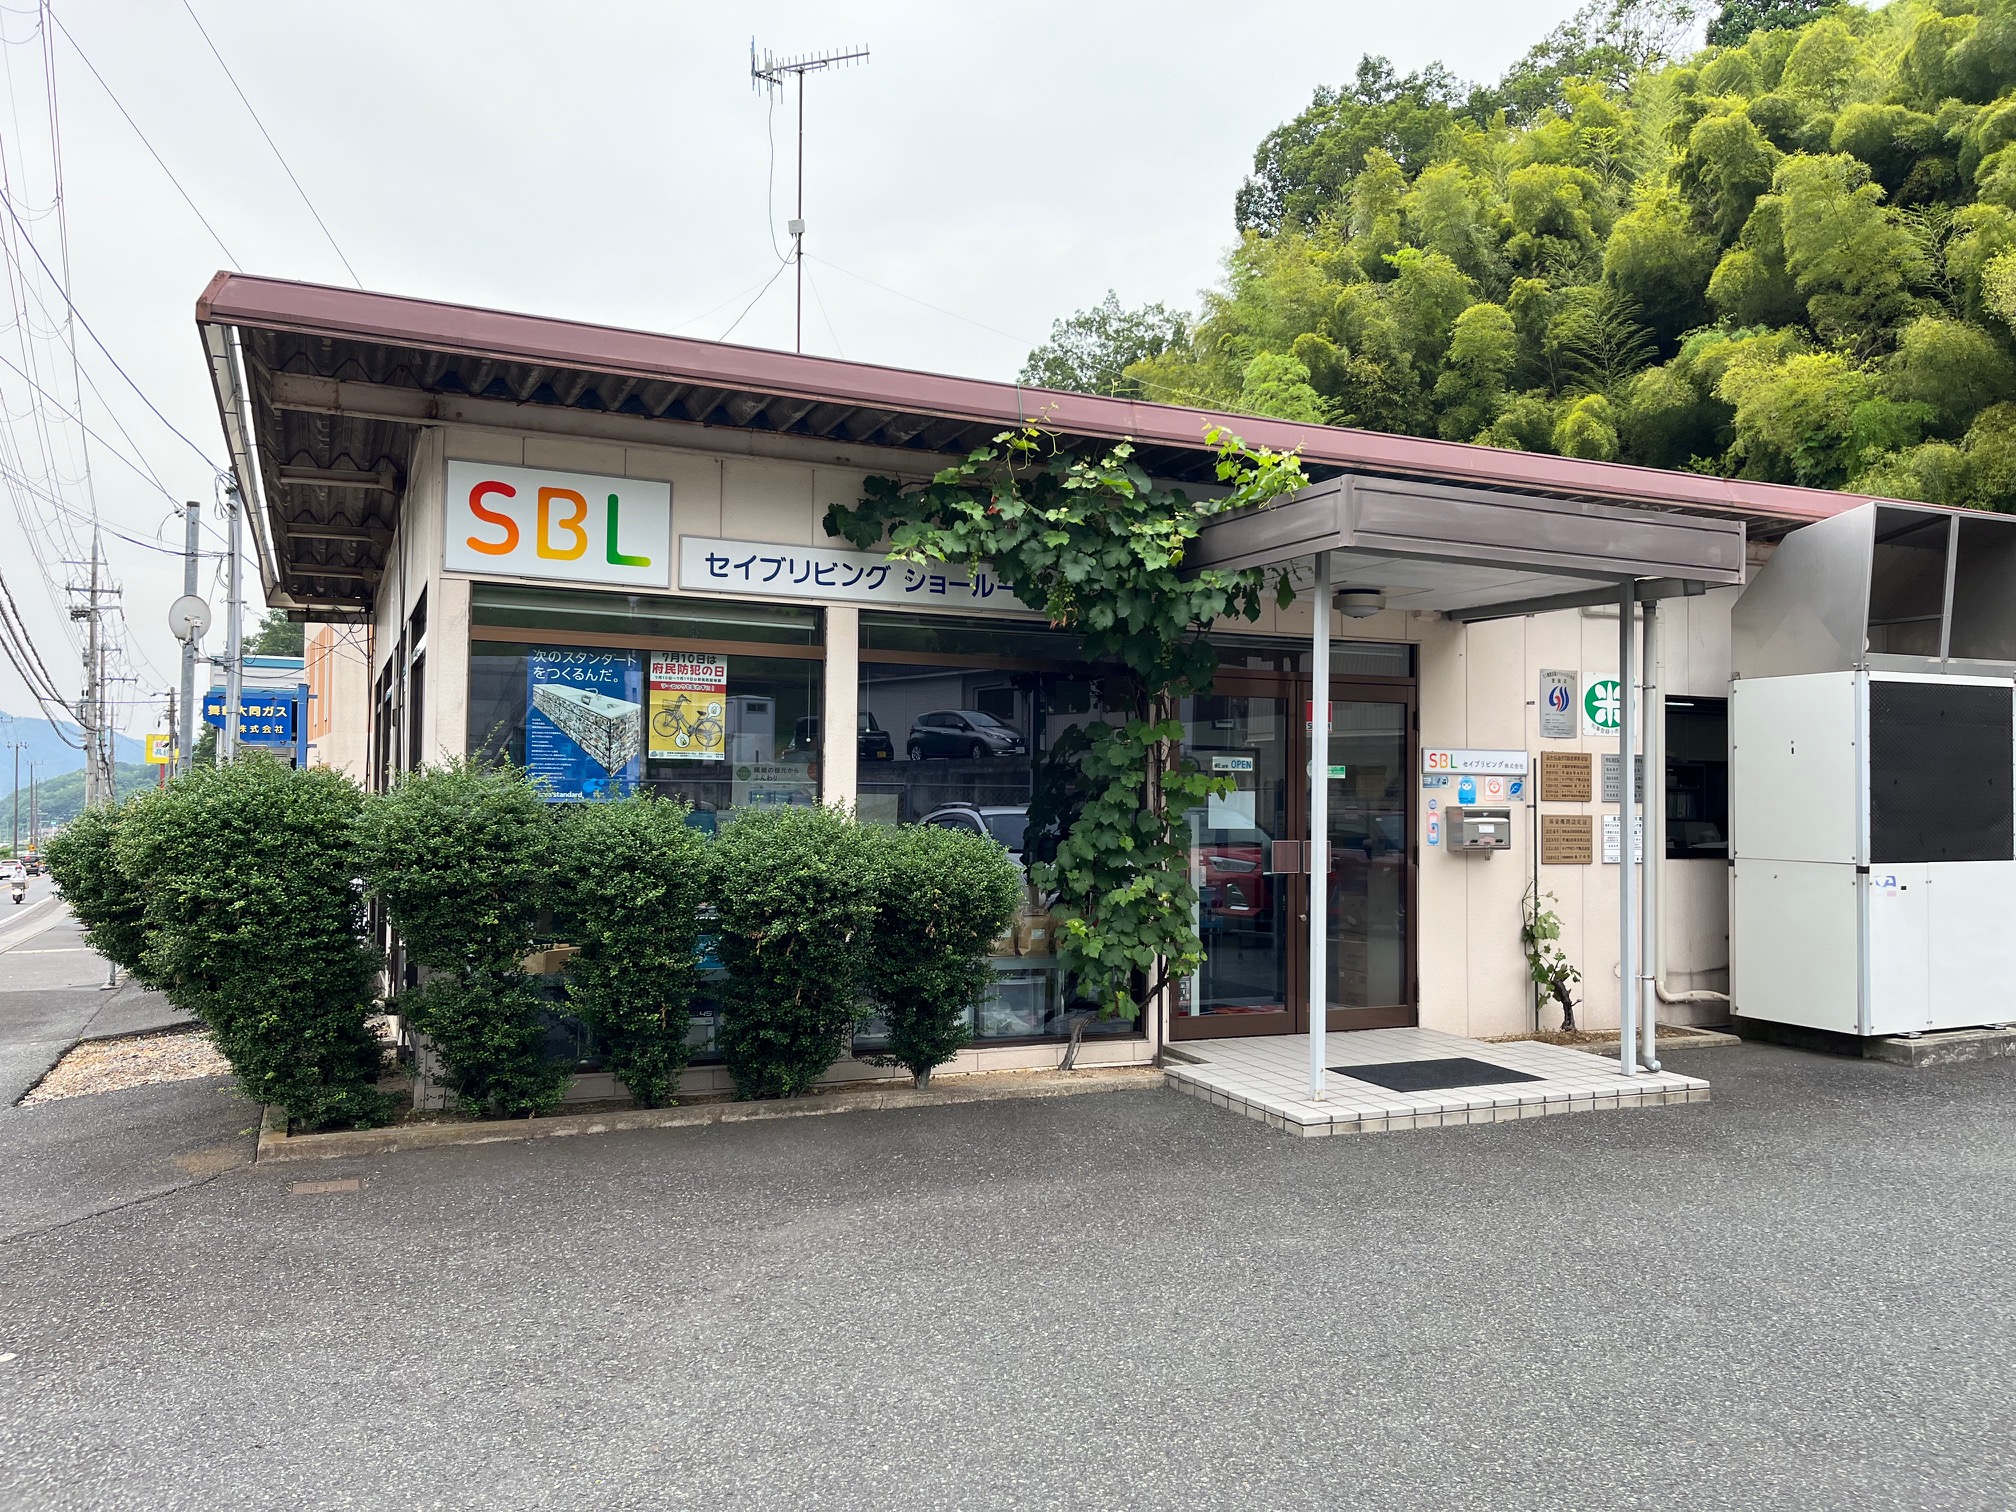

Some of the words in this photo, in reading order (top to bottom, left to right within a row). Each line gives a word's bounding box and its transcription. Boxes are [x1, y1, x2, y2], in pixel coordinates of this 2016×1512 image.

[466, 480, 652, 568] SBL
[705, 552, 891, 590] セイブリビング
[662, 652, 717, 665] 7月10日は
[533, 666, 619, 683] をつくるんだ。
[652, 662, 725, 677] 府民防犯の日
[1231, 759, 1252, 769] OPEN
[1429, 753, 1459, 769] SBL
